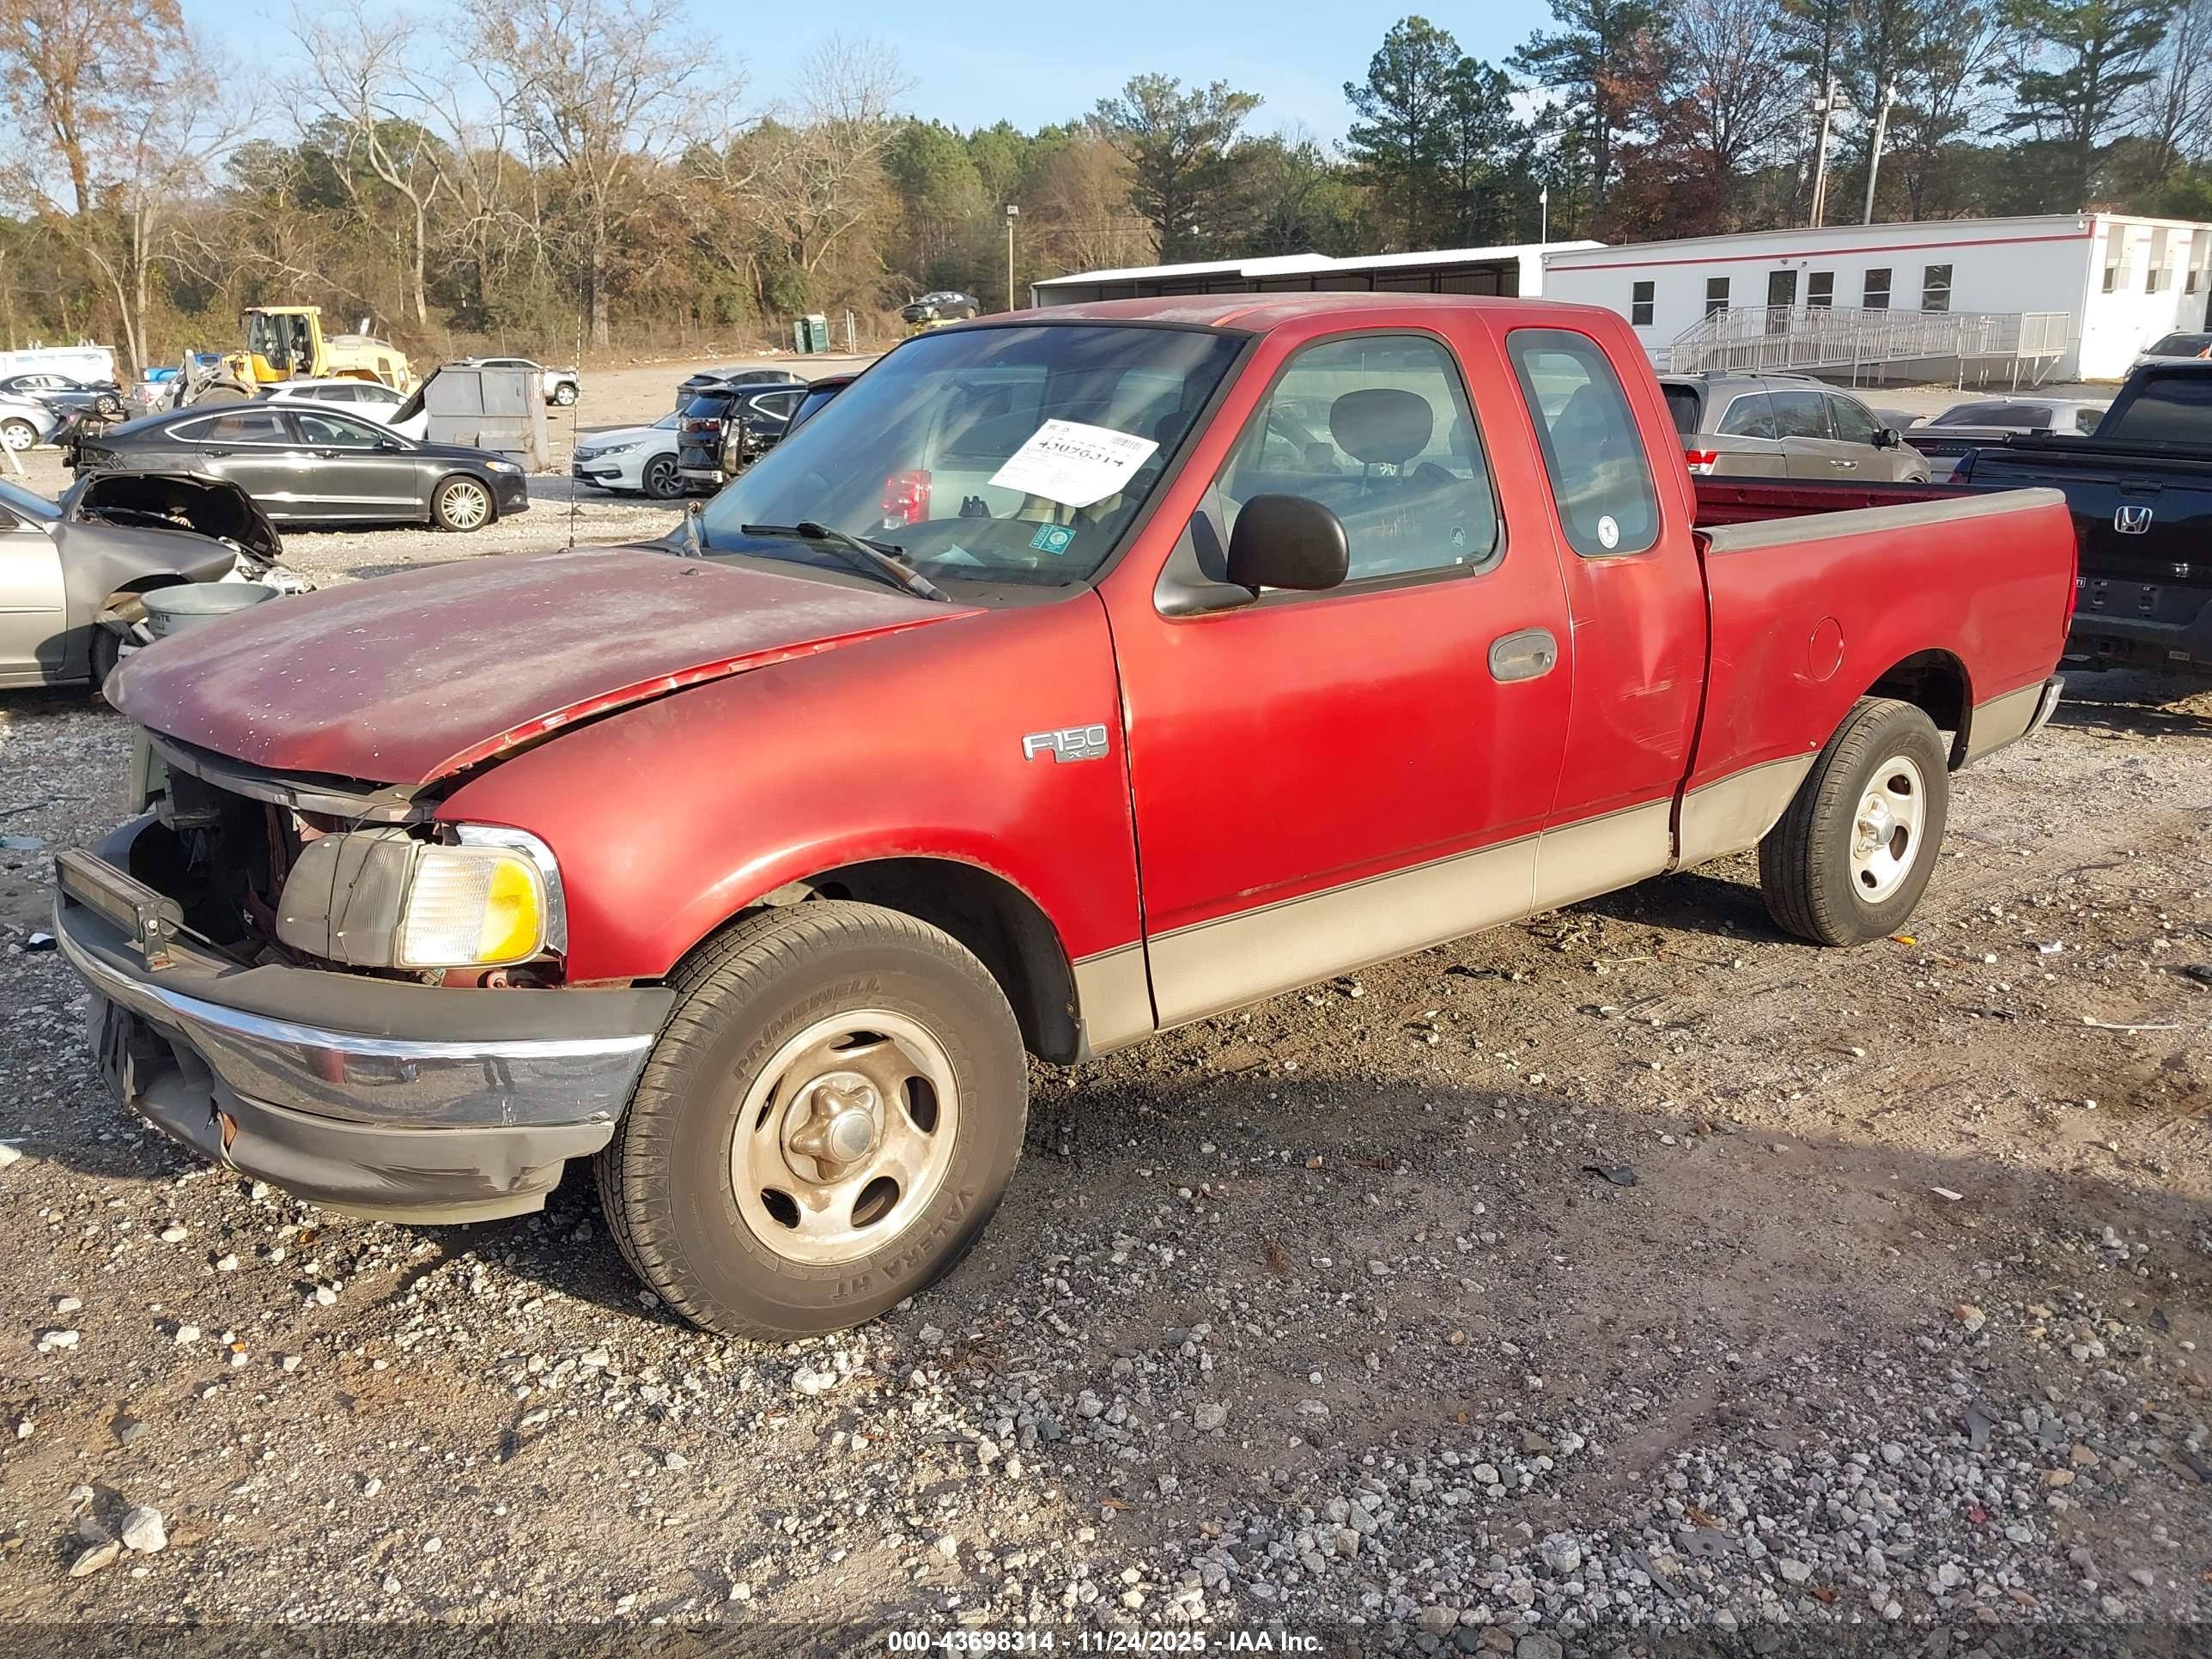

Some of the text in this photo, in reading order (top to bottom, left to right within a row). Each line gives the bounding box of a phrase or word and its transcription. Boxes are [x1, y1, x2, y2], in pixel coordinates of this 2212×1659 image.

[733, 975, 881, 1080] PRIMEWELL
[830, 1188, 975, 1300] VALERA HT
